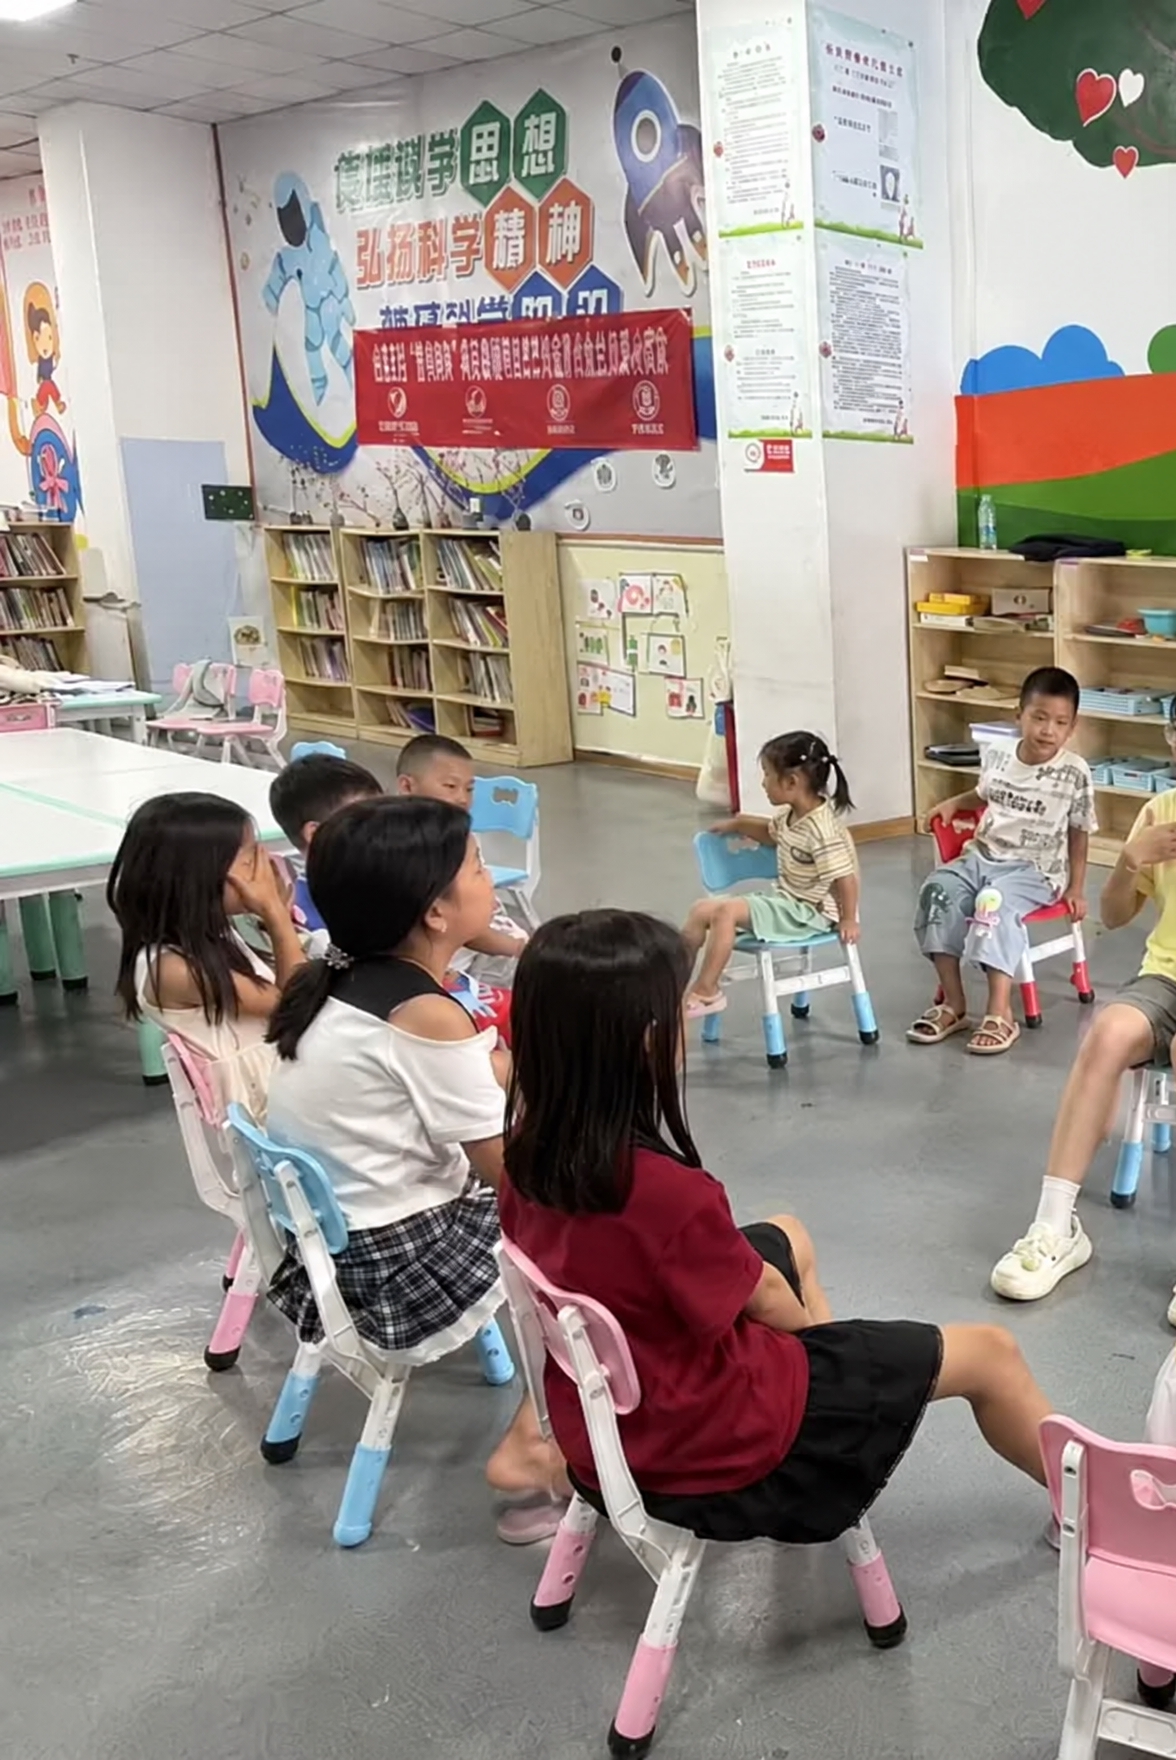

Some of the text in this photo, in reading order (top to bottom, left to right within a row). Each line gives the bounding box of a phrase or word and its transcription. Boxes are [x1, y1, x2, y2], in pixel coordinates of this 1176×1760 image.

[356, 200, 582, 289] 弘扬科学精神
